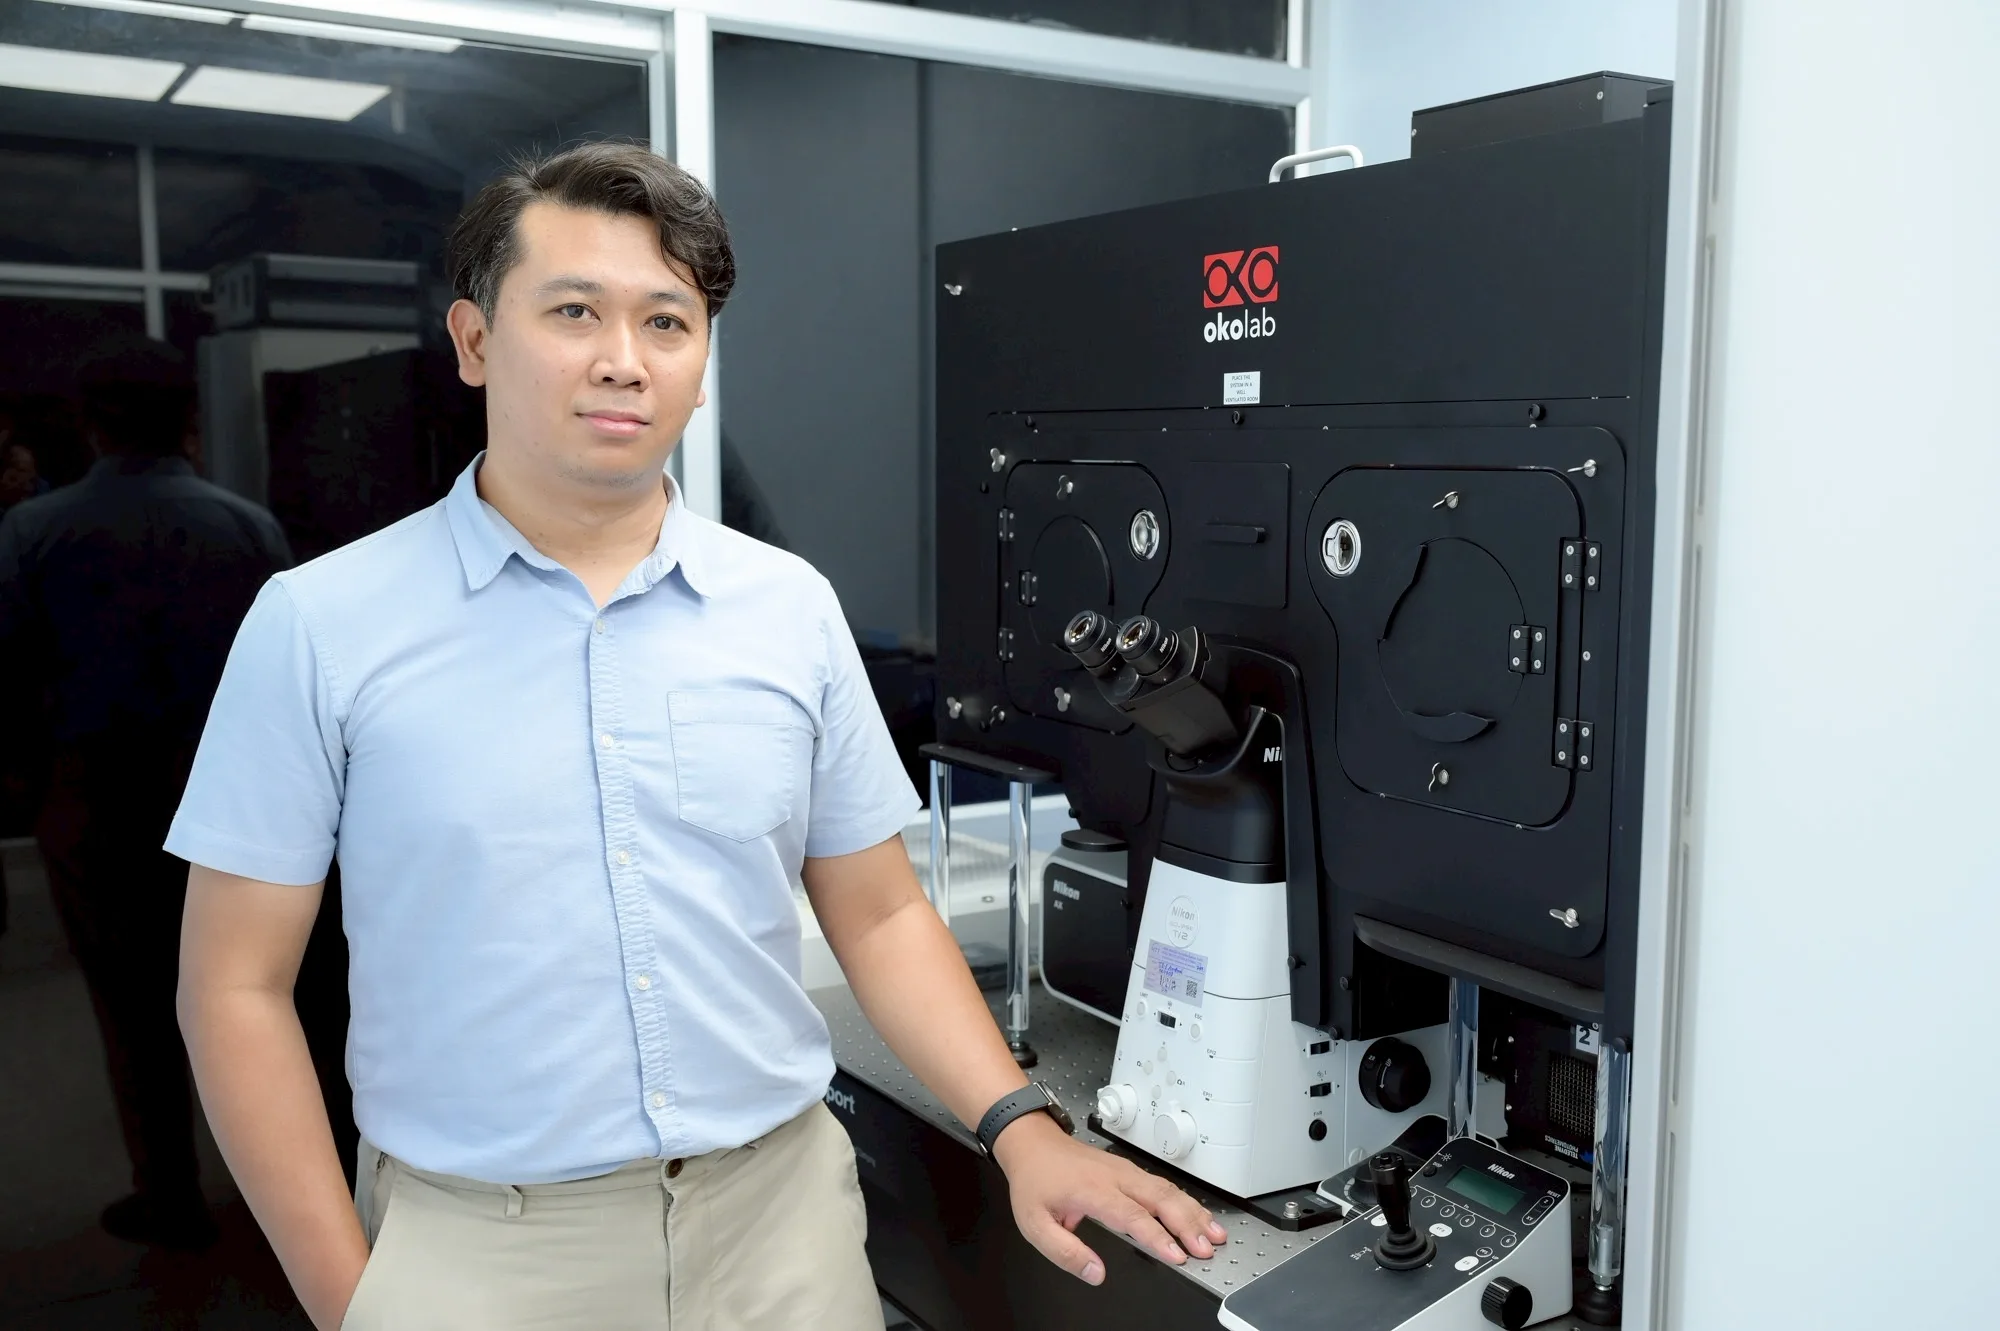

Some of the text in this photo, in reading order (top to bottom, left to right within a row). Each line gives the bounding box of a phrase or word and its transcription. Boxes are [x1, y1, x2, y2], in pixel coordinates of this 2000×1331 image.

[1203, 307, 1276, 343] okolab
[1053, 879, 1080, 901] Nikon
[1171, 905, 1195, 921] Nikon
[1578, 1026, 1591, 1046] 2
[826, 1085, 856, 1115] port
[1554, 1145, 1579, 1160] TELEDYNE
[1487, 1163, 1516, 1180] Nikon
[1546, 1189, 1561, 1199] RESET
